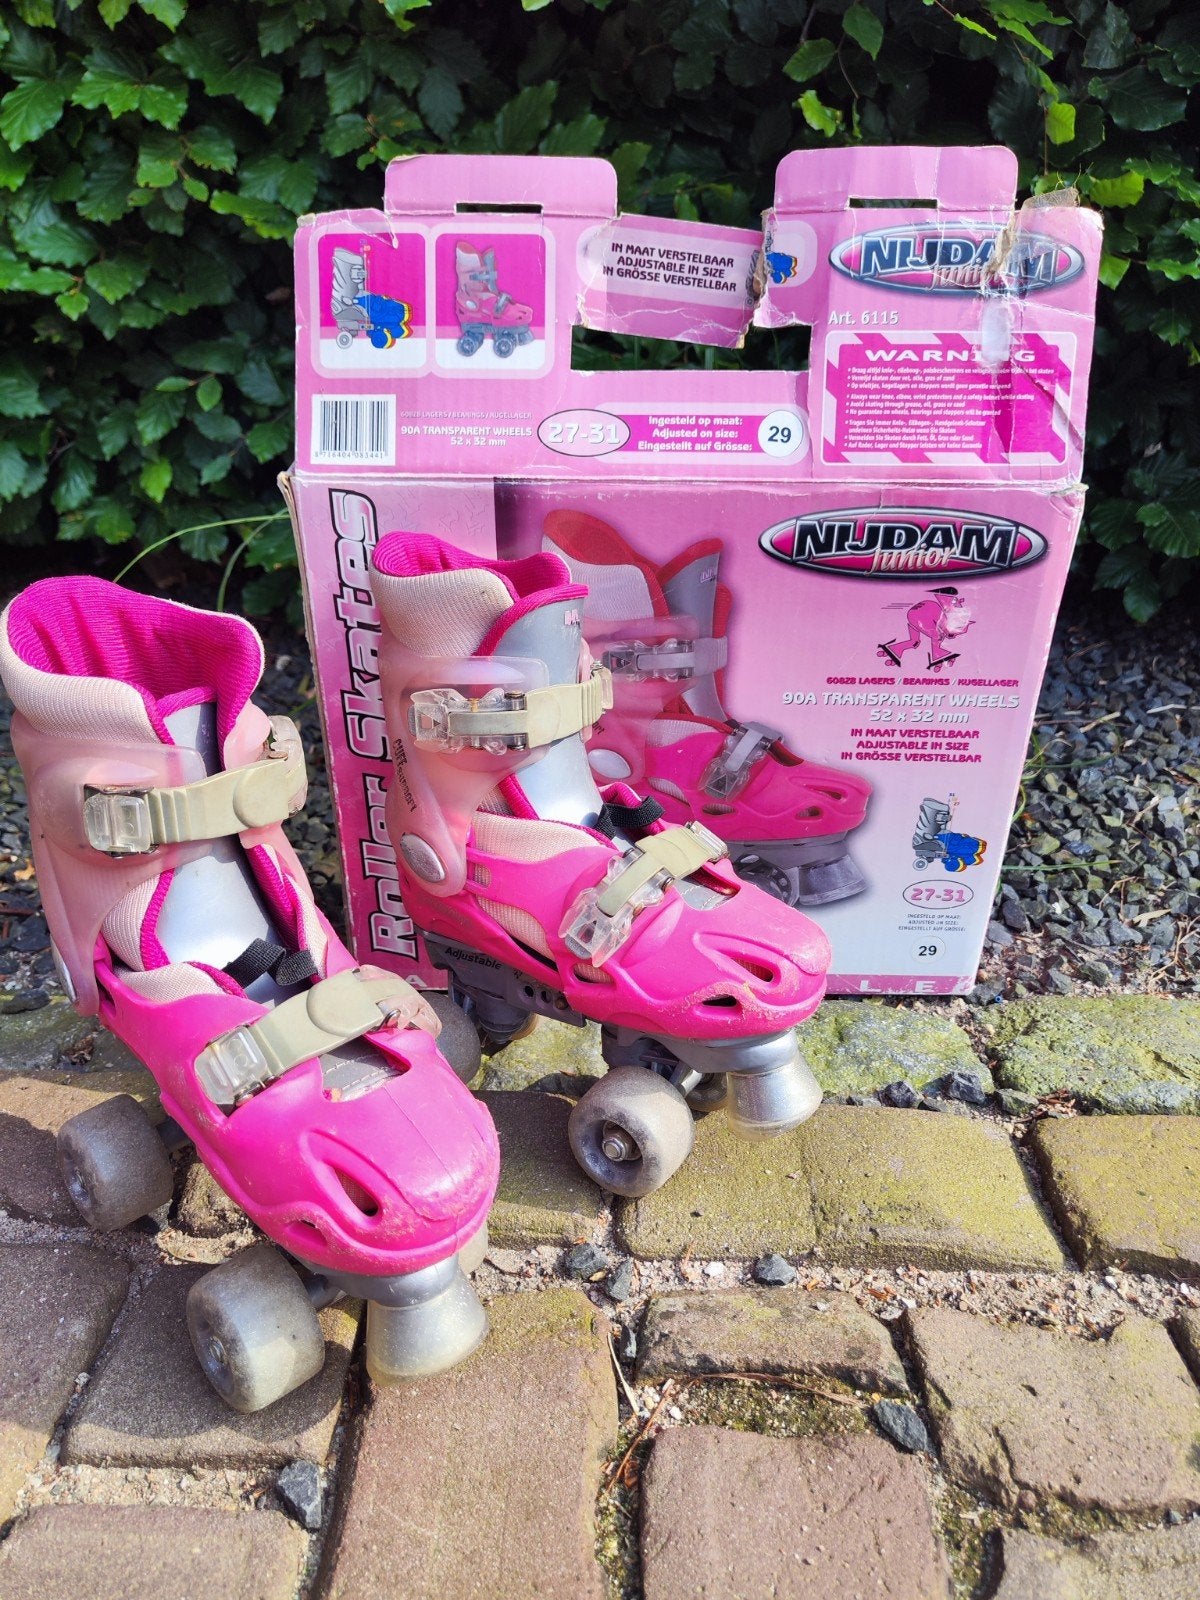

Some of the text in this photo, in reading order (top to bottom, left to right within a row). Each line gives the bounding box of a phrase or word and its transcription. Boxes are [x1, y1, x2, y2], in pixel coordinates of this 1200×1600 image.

[611, 242, 734, 268] IN MAAT VERSTELBAAR
[617, 256, 725, 279] ADJUSTABLE IN SIZE
[616, 266, 661, 283] GRÖSSE
[663, 276, 737, 292] VERSTELLBAR
[828, 311, 899, 325] Art. 6115
[865, 350, 1036, 362] WARNIG
[648, 416, 743, 427] Ingesteld op maat:
[401, 426, 532, 436] 90A TRANSPARENT WHEELS
[549, 422, 621, 445] 27-31
[652, 428, 739, 439] Adjusted on size:
[767, 425, 792, 444] 29
[450, 437, 464, 445] 52
[474, 437, 486, 446] 32
[637, 441, 753, 452] Eingestellt auf Grösse:
[793, 519, 1017, 568] NIJDAM
[858, 677, 896, 685] LAGERS
[903, 678, 950, 686] BEARINGS
[958, 679, 1019, 688] KUGELLAGER
[782, 692, 1020, 709] 90A TRANSPARENT WHEELS
[869, 709, 970, 724] 52 x 32 mm
[850, 729, 980, 739] IN MAAT VERSTELBAAR
[856, 741, 970, 751] ADJUSTABLE IN SIZE
[840, 750, 982, 763] IN GRÖSSE VERSTELLBAR
[911, 888, 966, 903] 27-31
[918, 945, 937, 957] 29
[444, 946, 502, 970] Adjustable
